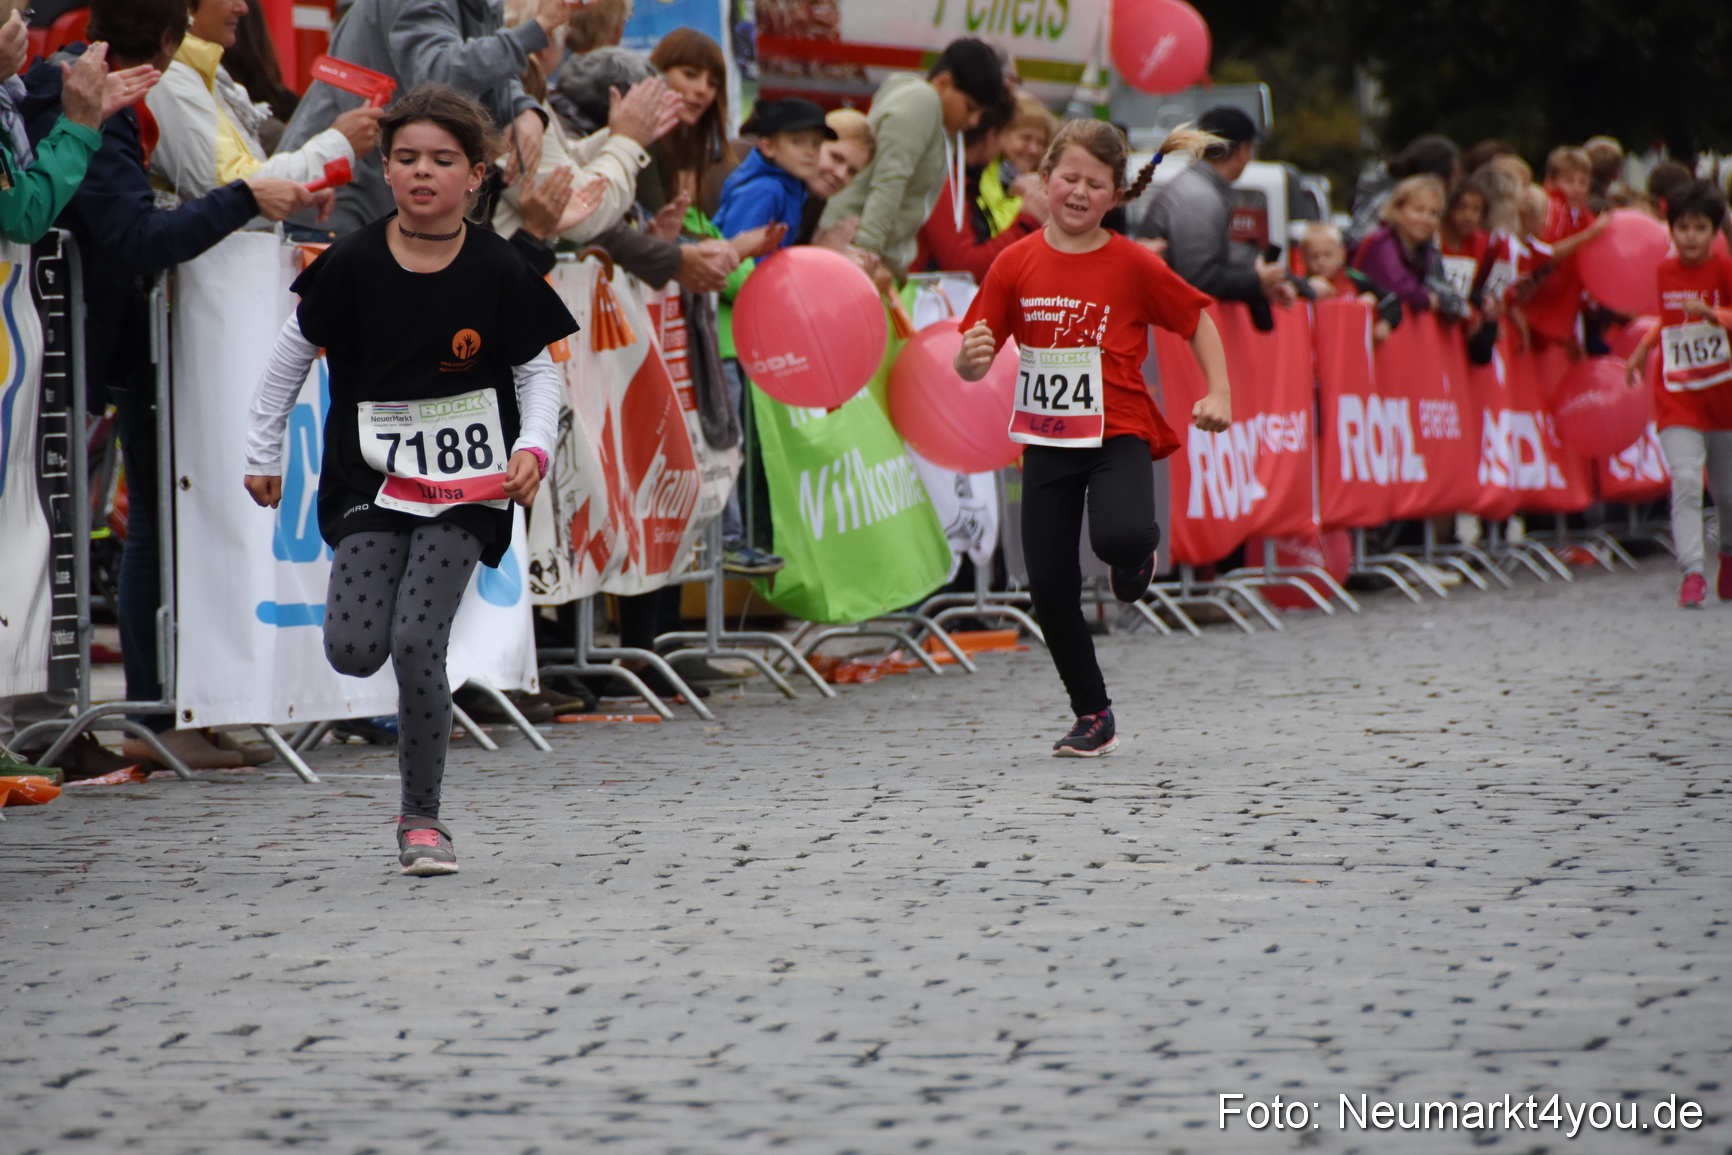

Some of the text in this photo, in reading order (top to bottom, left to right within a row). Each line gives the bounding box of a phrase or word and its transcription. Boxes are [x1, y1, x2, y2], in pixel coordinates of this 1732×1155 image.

[1024, 310, 1066, 325] tadtlauf
[1040, 352, 1092, 365] BOCK
[1669, 335, 1721, 366] 7152
[1020, 371, 1094, 410] 7424
[419, 395, 486, 419] BOCK
[371, 415, 413, 423] NeuerMarkt
[1030, 416, 1067, 435] LEA
[376, 422, 494, 476] 7188
[343, 503, 370, 519] SPIRO
